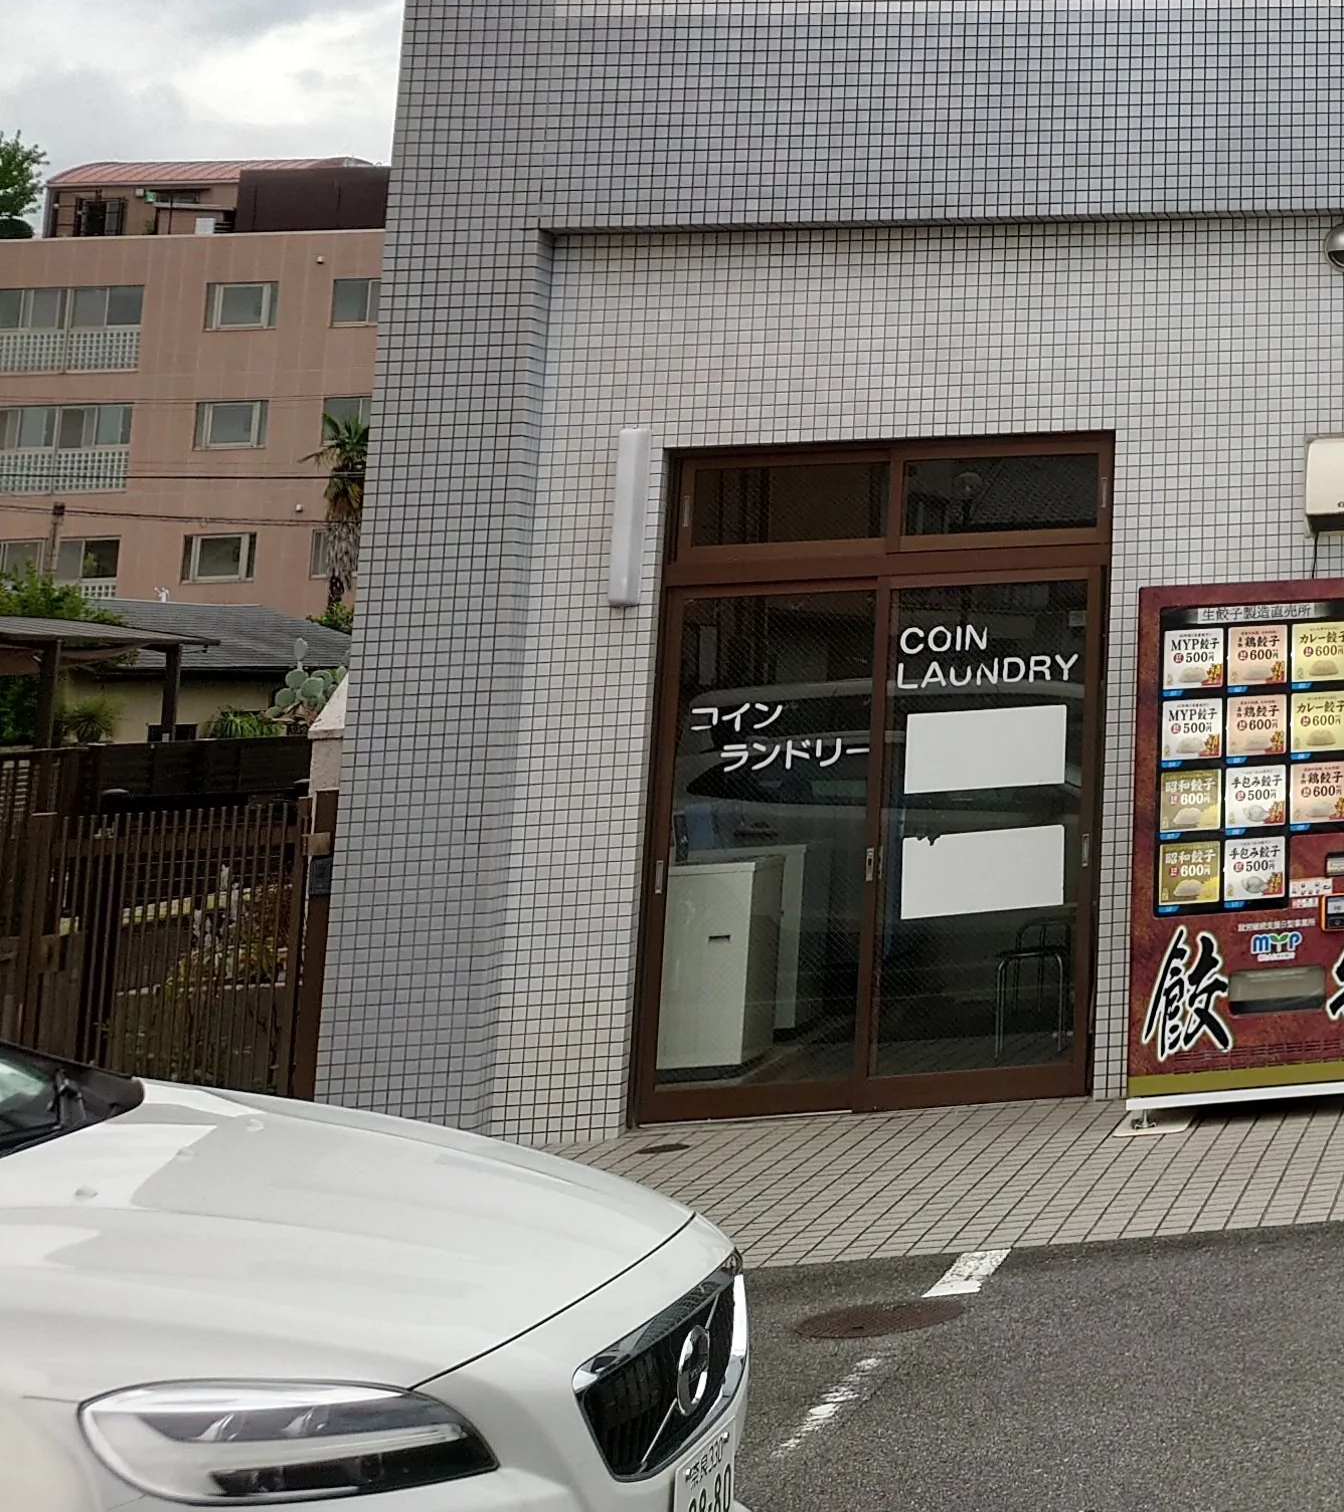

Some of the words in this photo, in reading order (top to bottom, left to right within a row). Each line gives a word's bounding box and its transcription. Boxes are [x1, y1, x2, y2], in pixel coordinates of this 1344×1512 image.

[1202, 604, 1311, 622] 生餃子製造直売所
[900, 624, 988, 653] COIN
[1170, 637, 1220, 652] MYP餃子
[897, 653, 1080, 689] LAUNDRY
[690, 702, 785, 732] コイン
[1168, 707, 1217, 722] MYP餃子
[720, 738, 871, 774] ランドリー
[1165, 778, 1216, 793] 昭和餃子
[1231, 775, 1282, 789] 手包み餃子
[1165, 850, 1216, 865] 昭和餃子
[1229, 845, 1281, 860] 手包み餃子
